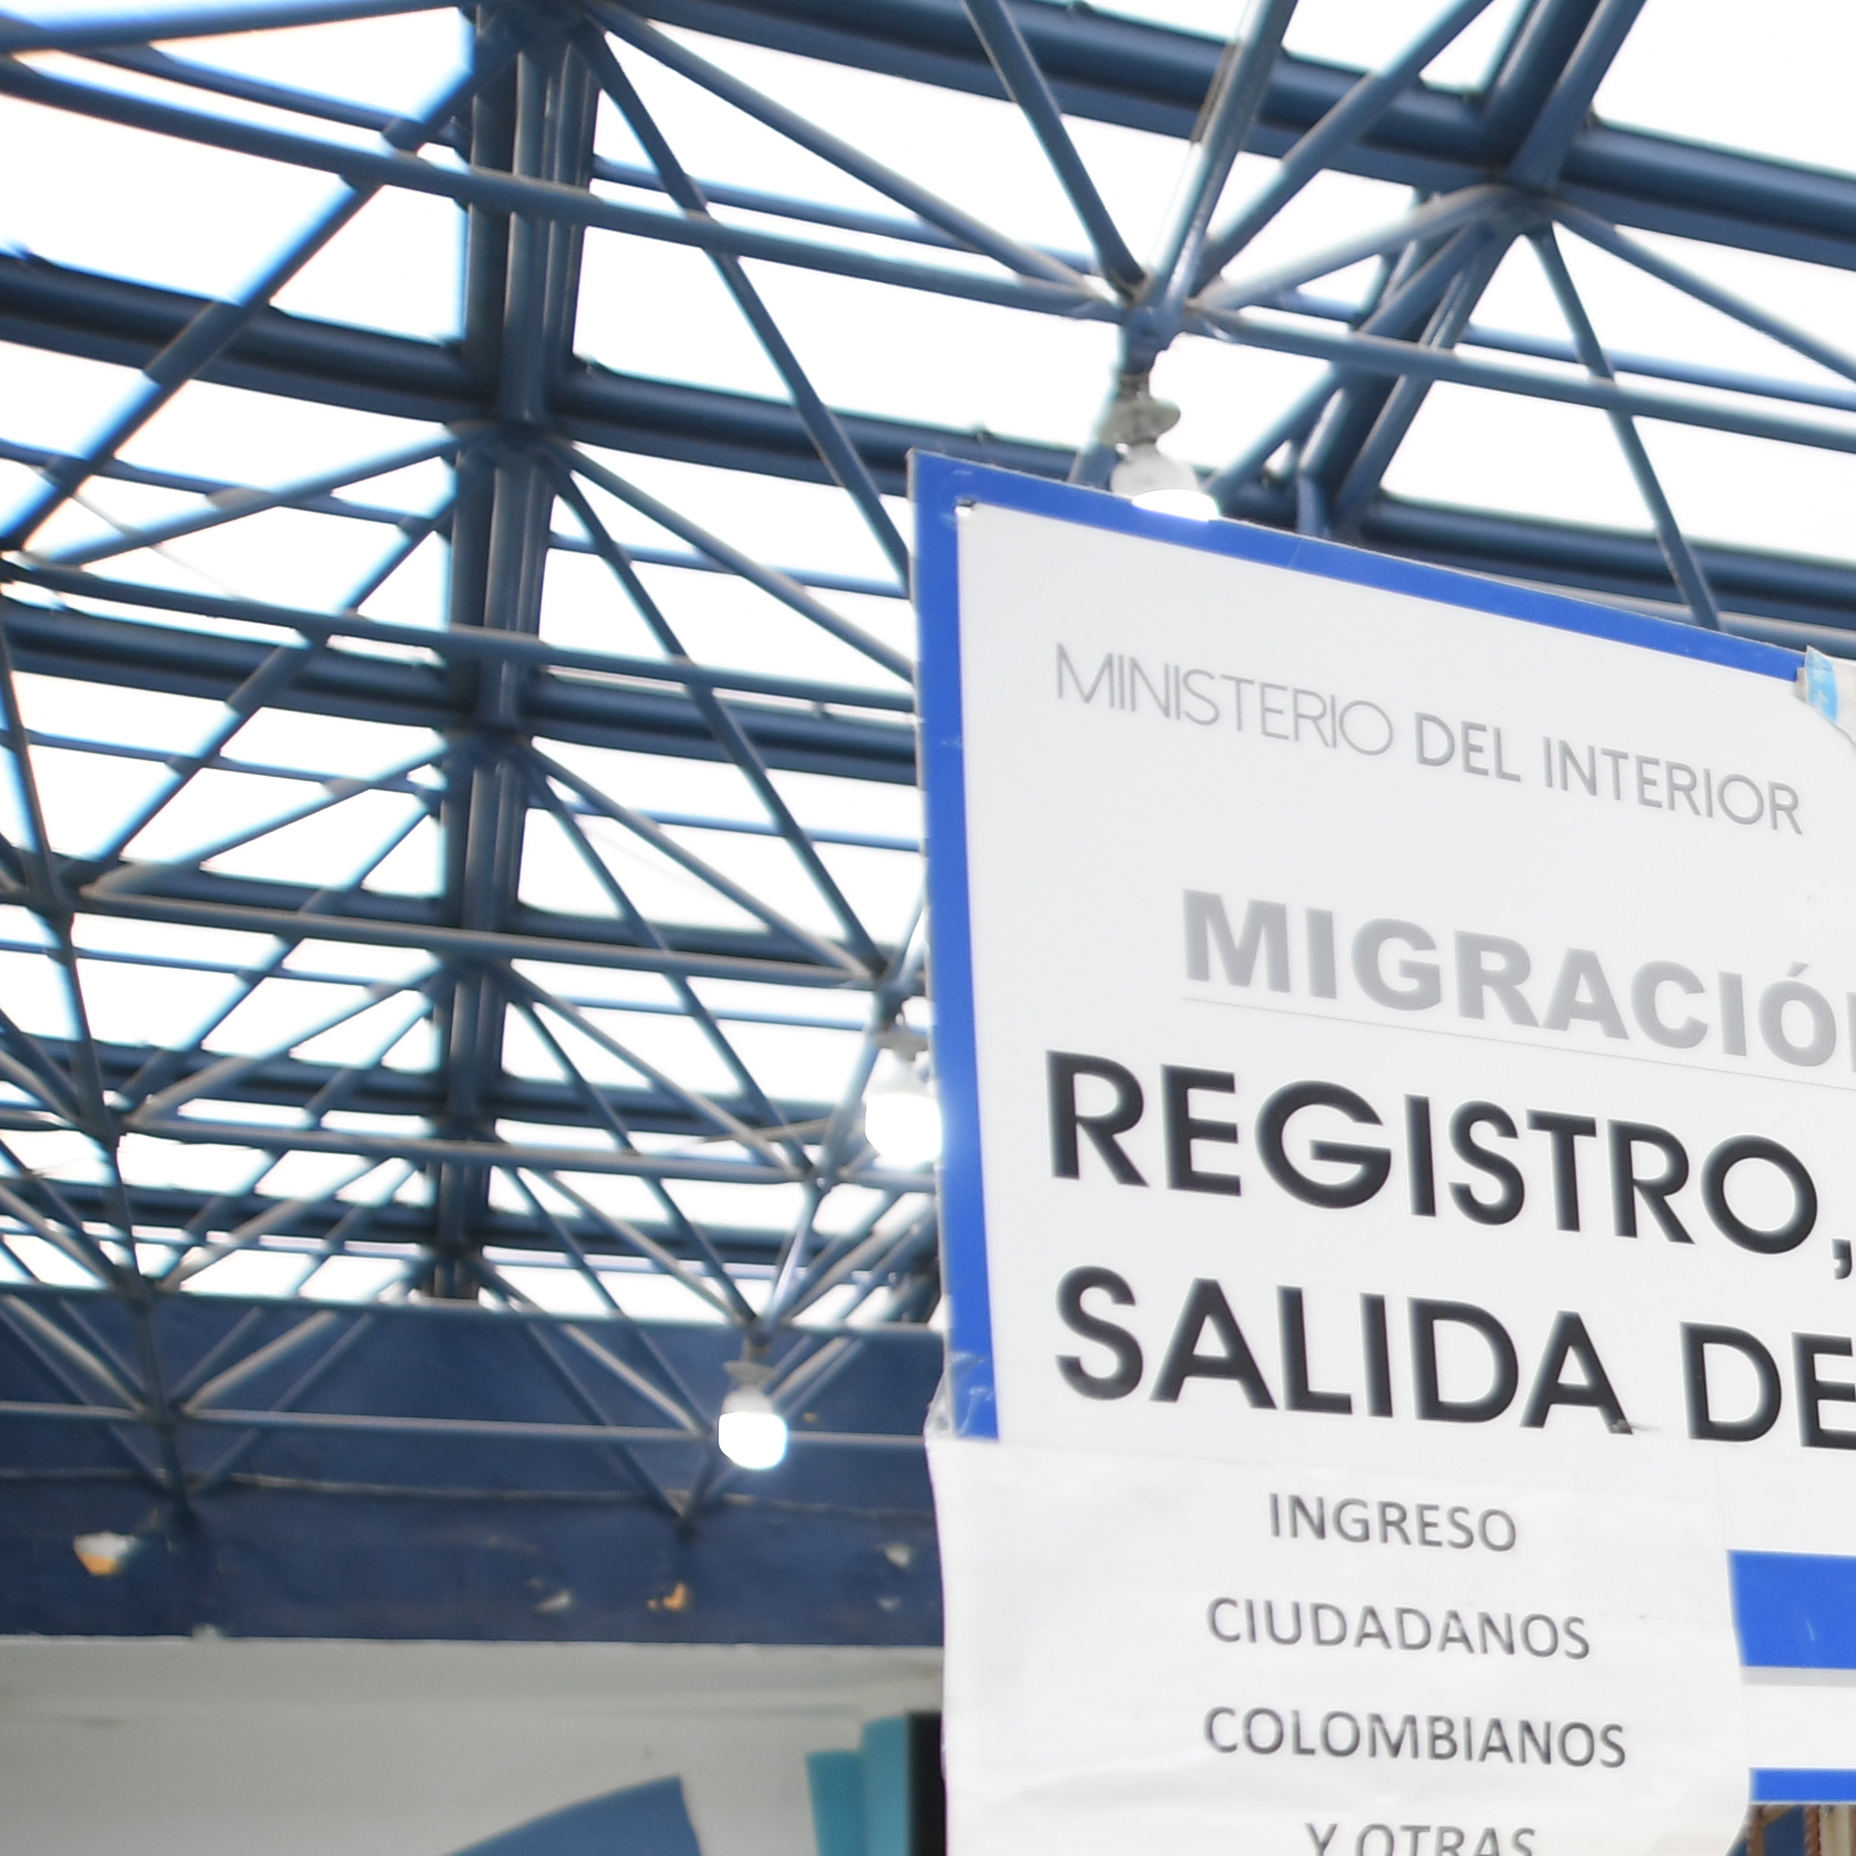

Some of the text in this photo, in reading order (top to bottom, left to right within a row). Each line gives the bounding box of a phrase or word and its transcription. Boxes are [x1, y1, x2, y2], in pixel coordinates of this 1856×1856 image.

[1055, 641, 1803, 836] MINISTERIO DEL INTERIOR
[1046, 1050, 1854, 1281] REGISTRO,
[1057, 1265, 1635, 1437] SALIDA
[1271, 1493, 1516, 1552] INGRESO
[1208, 1597, 1591, 1661] CIUDADANOS
[1204, 1706, 1627, 1769] COLOMBIANOS
